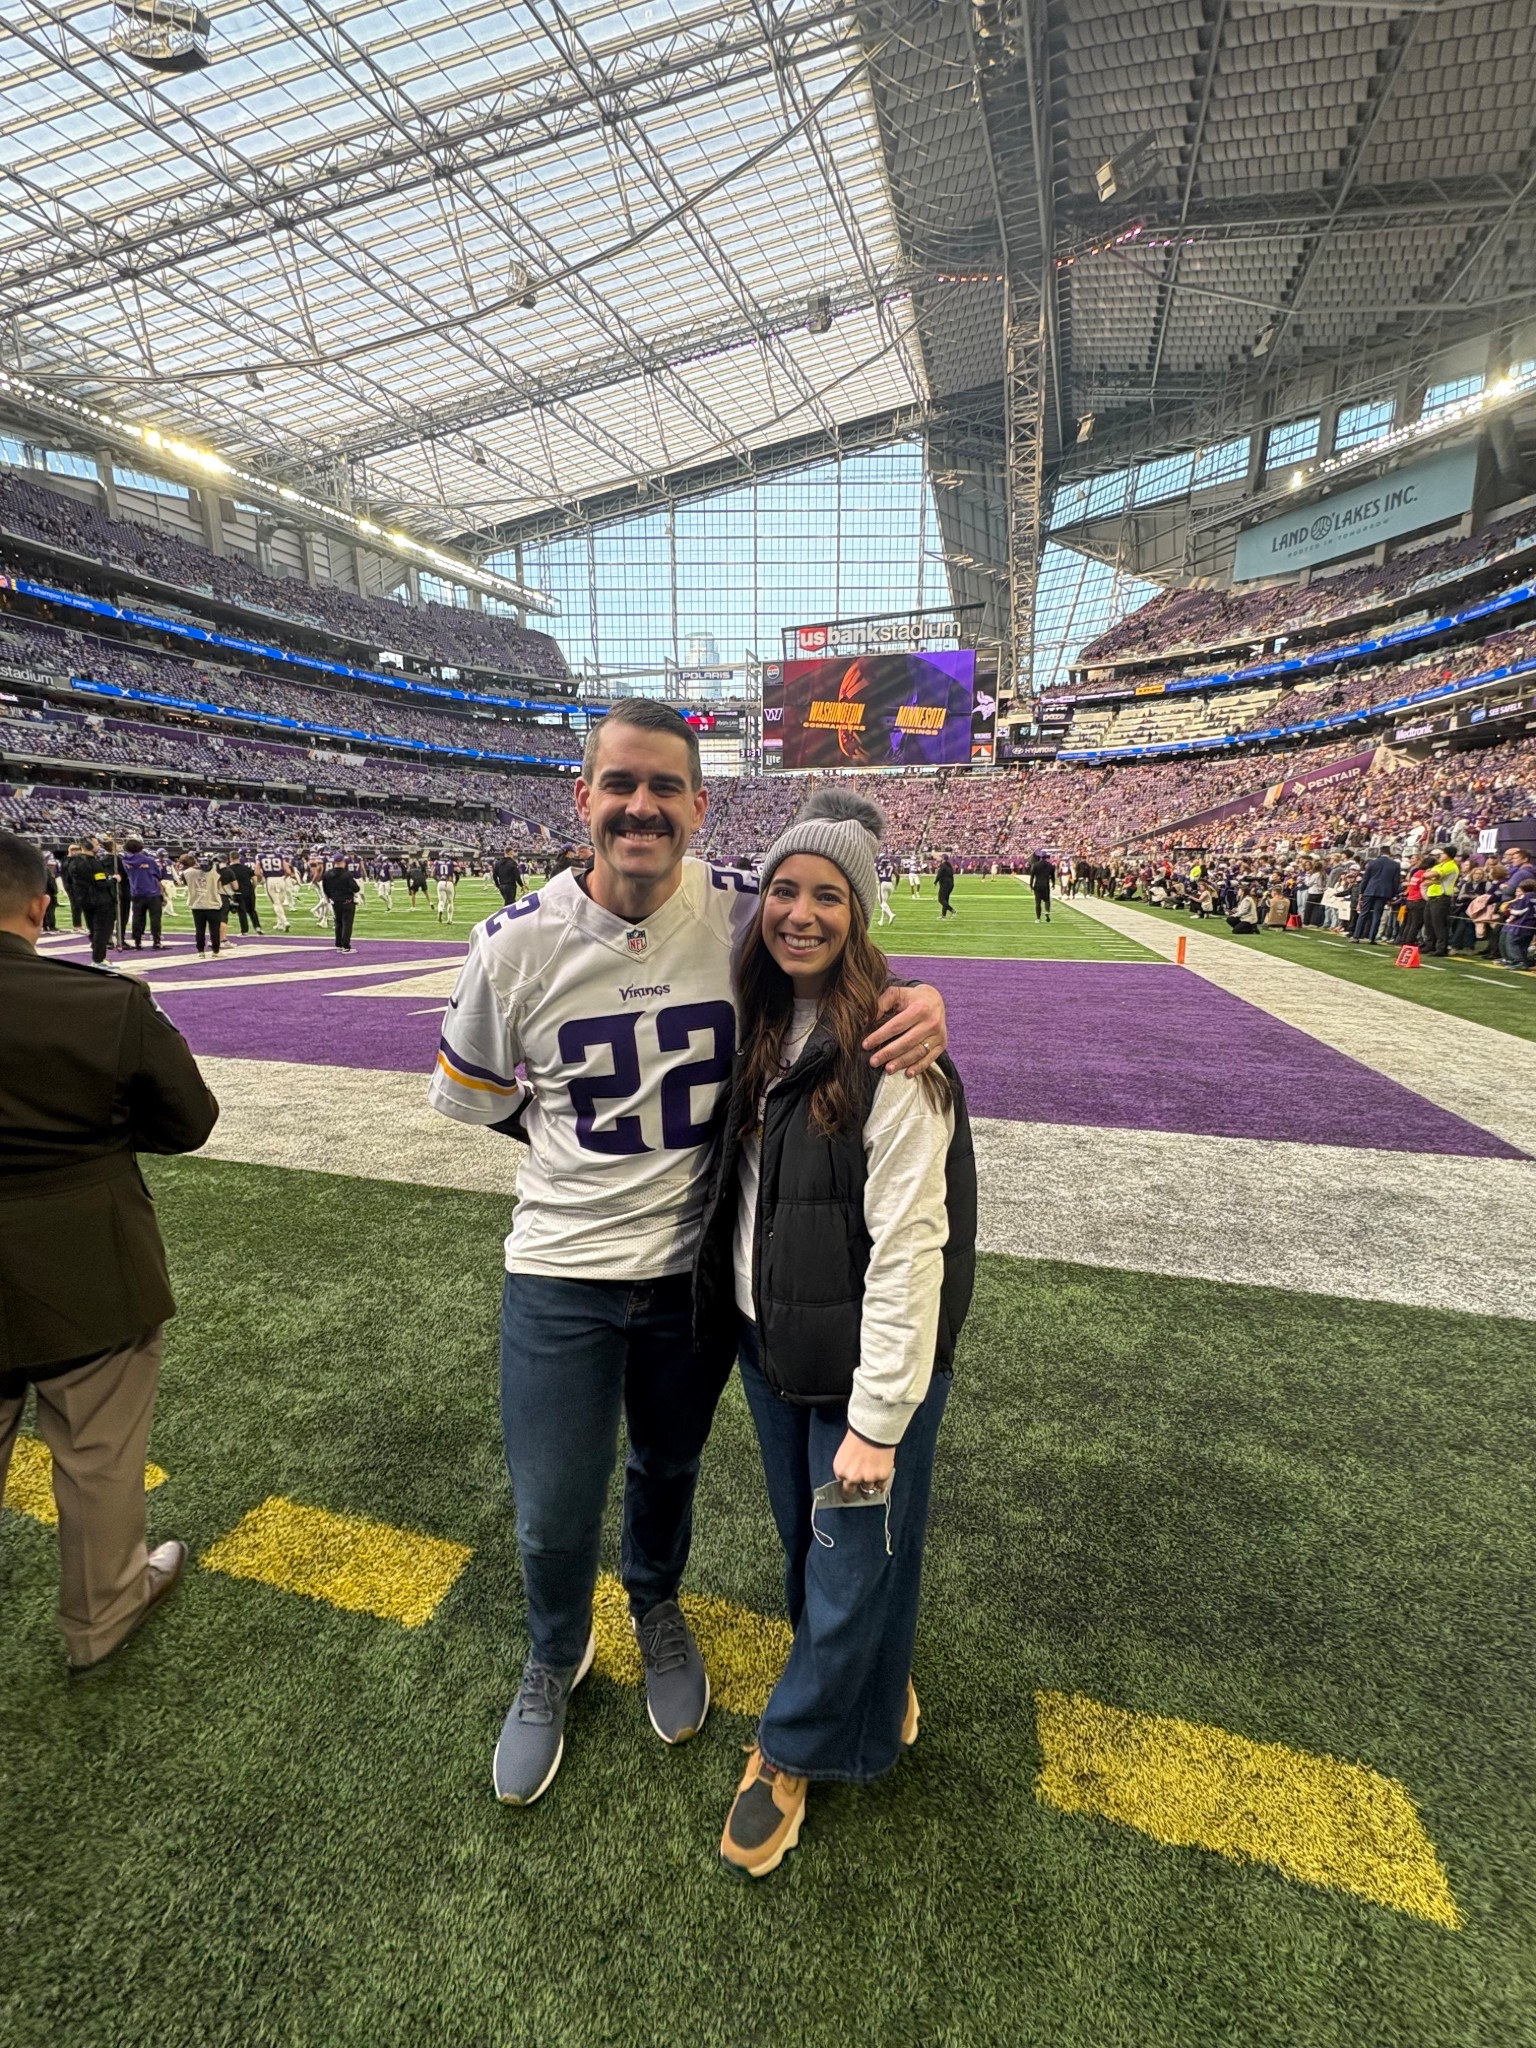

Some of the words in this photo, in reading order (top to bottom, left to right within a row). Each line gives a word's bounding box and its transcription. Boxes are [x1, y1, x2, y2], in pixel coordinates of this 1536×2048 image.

[1271, 527, 1309, 553] LAND
[1384, 485, 1418, 513] INC.
[27, 585, 33, 593] A
[33, 588, 63, 600] champion
[64, 595, 72, 603] for
[72, 598, 95, 609] people.
[682, 672, 731, 680] POLARIS
[808, 700, 867, 725] WASHINGTON
[894, 705, 947, 730] MINNESOTA
[802, 721, 867, 732] COMMANDERS
[900, 727, 939, 736] VIKINGS
[1395, 723, 1435, 741] Medtronic
[1307, 767, 1361, 790] PENTAIR
[261, 858, 282, 872] 89
[629, 938, 646, 950] NFL
[558, 1000, 737, 1155] 22
